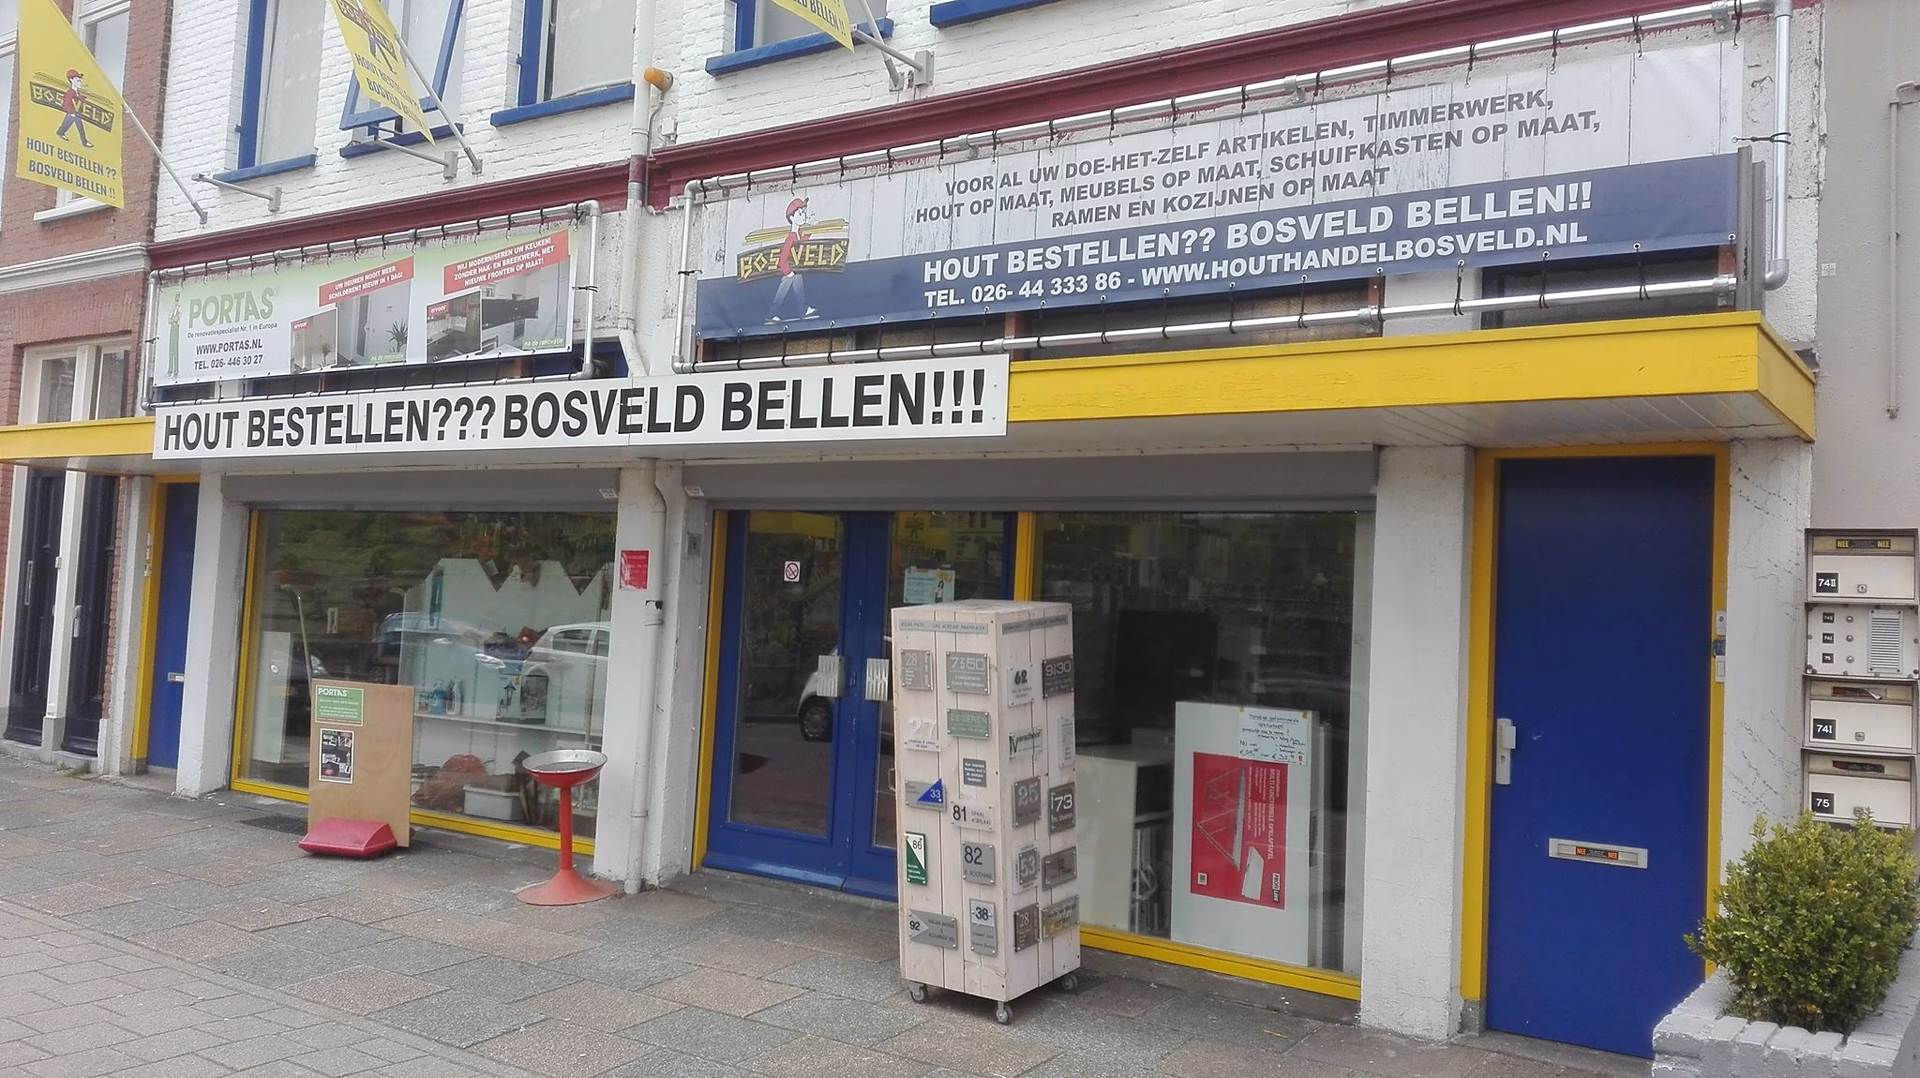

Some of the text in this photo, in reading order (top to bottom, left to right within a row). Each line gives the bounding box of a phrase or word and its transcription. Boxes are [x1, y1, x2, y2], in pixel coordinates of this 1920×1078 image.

[945, 89, 1554, 197] VOOR AL UW DOE-HET-ZELF ARTIKELEN, TIMMERWERK,
[26, 137, 117, 180] HOUT BESTELLEN ??
[916, 110, 1601, 224] HOUT OP MAAT, MEUBELS OP MAAT, SCHUIFKASTEN OP MAAT,
[29, 160, 74, 184] BOSVELD
[75, 175, 107, 197] BELLEN
[1052, 166, 1390, 228] RAMEN EN KOZIJNEN OP MAAT
[924, 181, 1593, 283] HOUT BESTELLEN?? BOSVELD BELLEN!!
[454, 269, 478, 281] ZONDER
[493, 262, 502, 270] EN
[541, 245, 555, 256] MET
[468, 250, 513, 268] MODERNISEREN
[514, 244, 525, 255] UW
[740, 241, 845, 279] BOSVELD
[924, 290, 965, 308] TEL.
[971, 283, 1013, 305] 026-
[1018, 278, 1044, 298] 44
[1050, 274, 1088, 297] 333
[1095, 270, 1122, 292] 86
[1142, 222, 1588, 286] WWW.HOUTHANDELBOSVELD.NL
[344, 276, 365, 289] DEUREN
[365, 270, 381, 281] NOOIT
[381, 265, 397, 276] MEER
[464, 274, 487, 287] NIEUWE
[487, 267, 515, 280] FRONTEN
[516, 263, 525, 272] OP
[362, 280, 379, 291] NIEUW
[188, 287, 275, 329] PORTAS
[195, 326, 240, 338] renovatiespecialist
[258, 322, 278, 331] Europa
[196, 338, 263, 355] WWW.PORTAS.NL
[194, 361, 209, 371] TEL.
[227, 356, 241, 367] 446
[242, 355, 252, 366] 30
[253, 354, 263, 365] 27
[163, 368, 986, 451] HOUT BESTELLEN??? BOSVELD BELLEN!!!
[1837, 540, 1850, 548] NEE
[1877, 540, 1890, 548] NEE
[905, 653, 918, 667] 28
[1014, 669, 1028, 685] 62
[318, 687, 348, 698] PORTAS
[907, 717, 937, 741] 27
[930, 788, 941, 799] 33
[1816, 798, 1830, 808] 75
[952, 804, 967, 822] 81
[912, 839, 923, 851] 86
[963, 846, 983, 866] 82
[1020, 856, 1036, 877] 53
[975, 906, 989, 921] 38
[909, 920, 921, 932] 92
